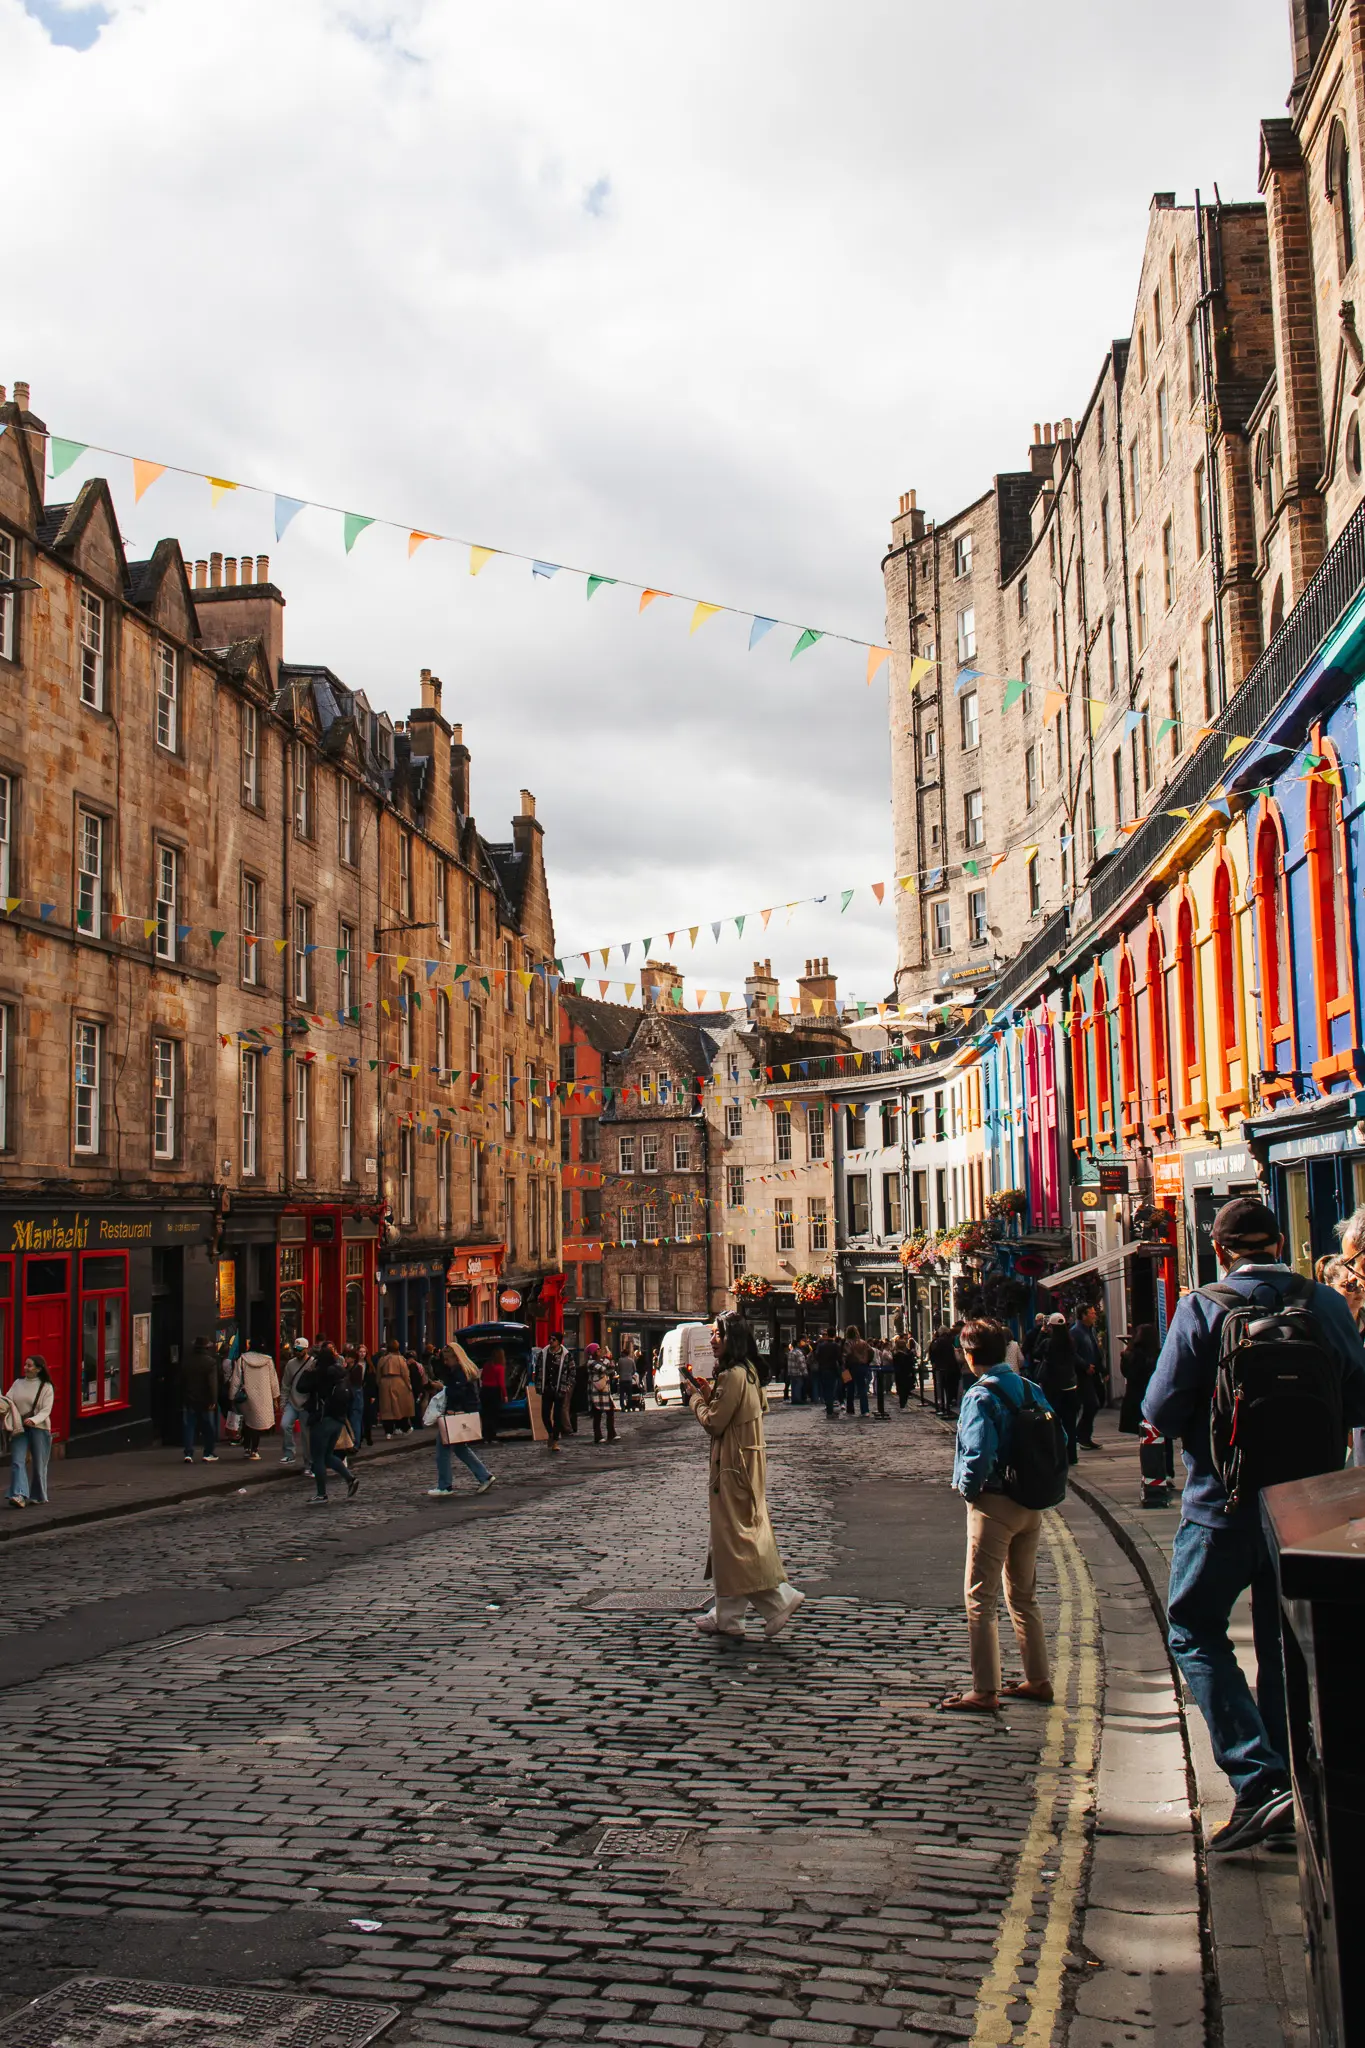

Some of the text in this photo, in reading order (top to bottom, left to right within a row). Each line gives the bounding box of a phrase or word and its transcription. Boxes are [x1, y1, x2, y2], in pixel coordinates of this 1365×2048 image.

[1195, 1160, 1206, 1176] THE
[1206, 1155, 1228, 1177] WHISKY
[1229, 1153, 1246, 1173] SHOP
[11, 1212, 152, 1251] Mariachi Restaurant
[467, 1257, 482, 1276] Squish
[501, 1296, 520, 1304] Squish
